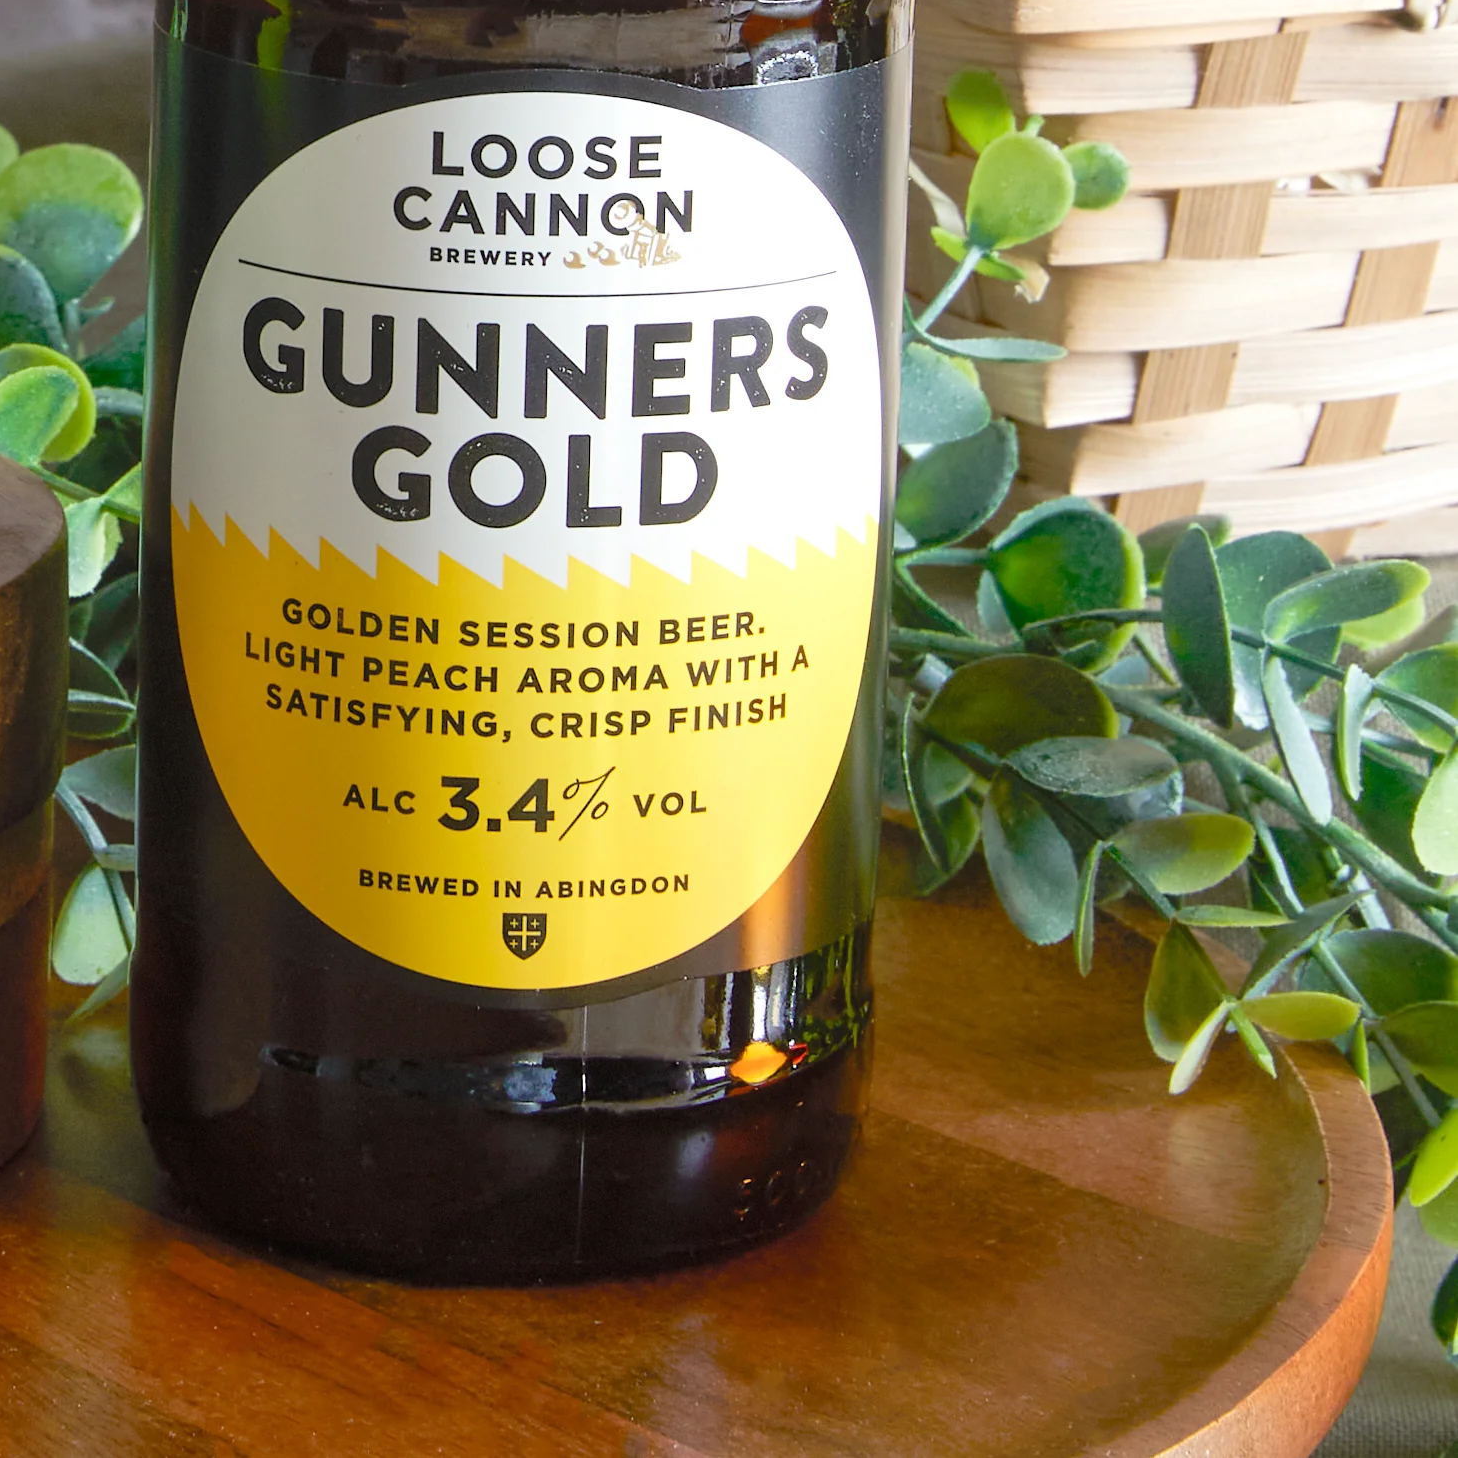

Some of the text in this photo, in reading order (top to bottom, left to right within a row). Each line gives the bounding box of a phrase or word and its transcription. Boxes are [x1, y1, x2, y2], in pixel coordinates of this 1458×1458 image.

[432, 131, 662, 179] LOOSE
[393, 186, 692, 236] CANNON
[430, 247, 551, 266] BREWERY
[242, 296, 829, 420] GUNNERS
[351, 425, 718, 528] GOLD
[281, 598, 764, 648] GOLDEN SESSION BEER.
[246, 631, 808, 693] LIGHT PEACH AROMA WITH A
[266, 682, 785, 742] SATISFYING, CRISP FINISH
[343, 767, 706, 840] ALC 3.4% VOL
[359, 869, 688, 898] BREWED IN ABINGDON
